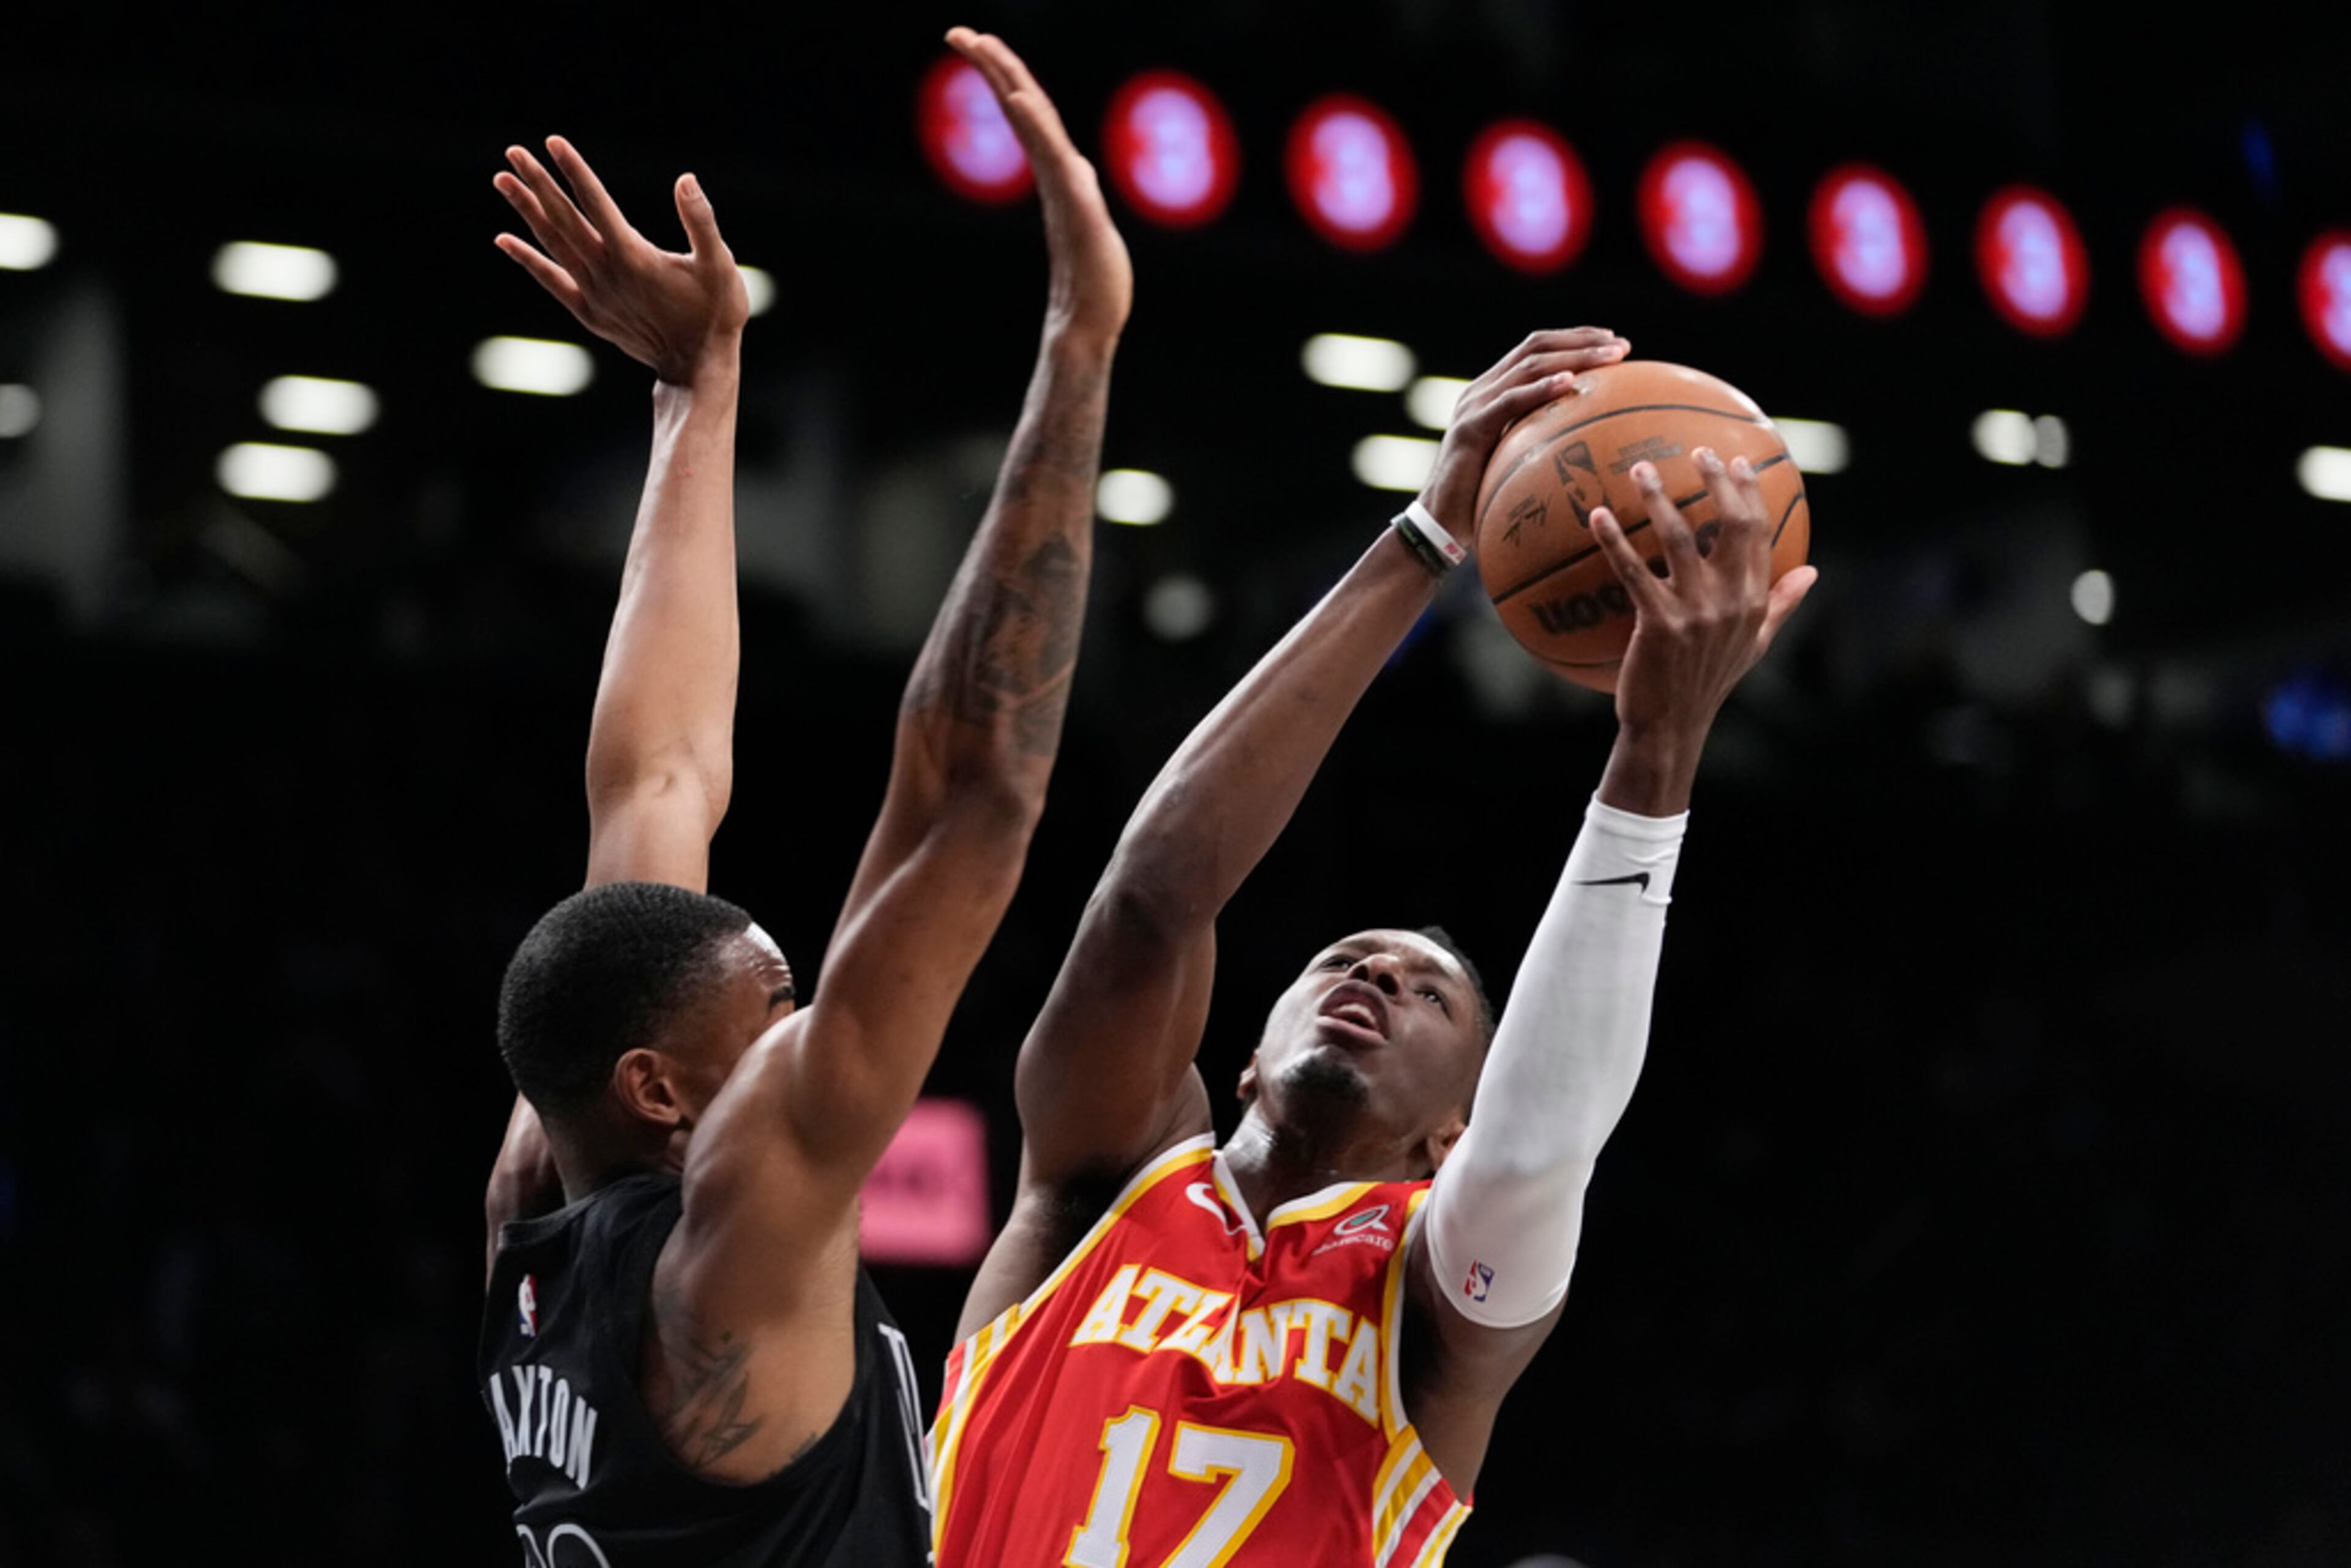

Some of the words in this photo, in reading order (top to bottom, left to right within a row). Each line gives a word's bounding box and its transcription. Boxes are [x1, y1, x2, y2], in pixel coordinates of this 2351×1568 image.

[1313, 113, 1395, 232] 3
[1490, 136, 1570, 255] 3
[1664, 158, 1741, 277] 3
[1833, 179, 1907, 298] 3
[1068, 1263, 1382, 1430] ATLANTA
[1062, 1404, 1295, 1568] 17
